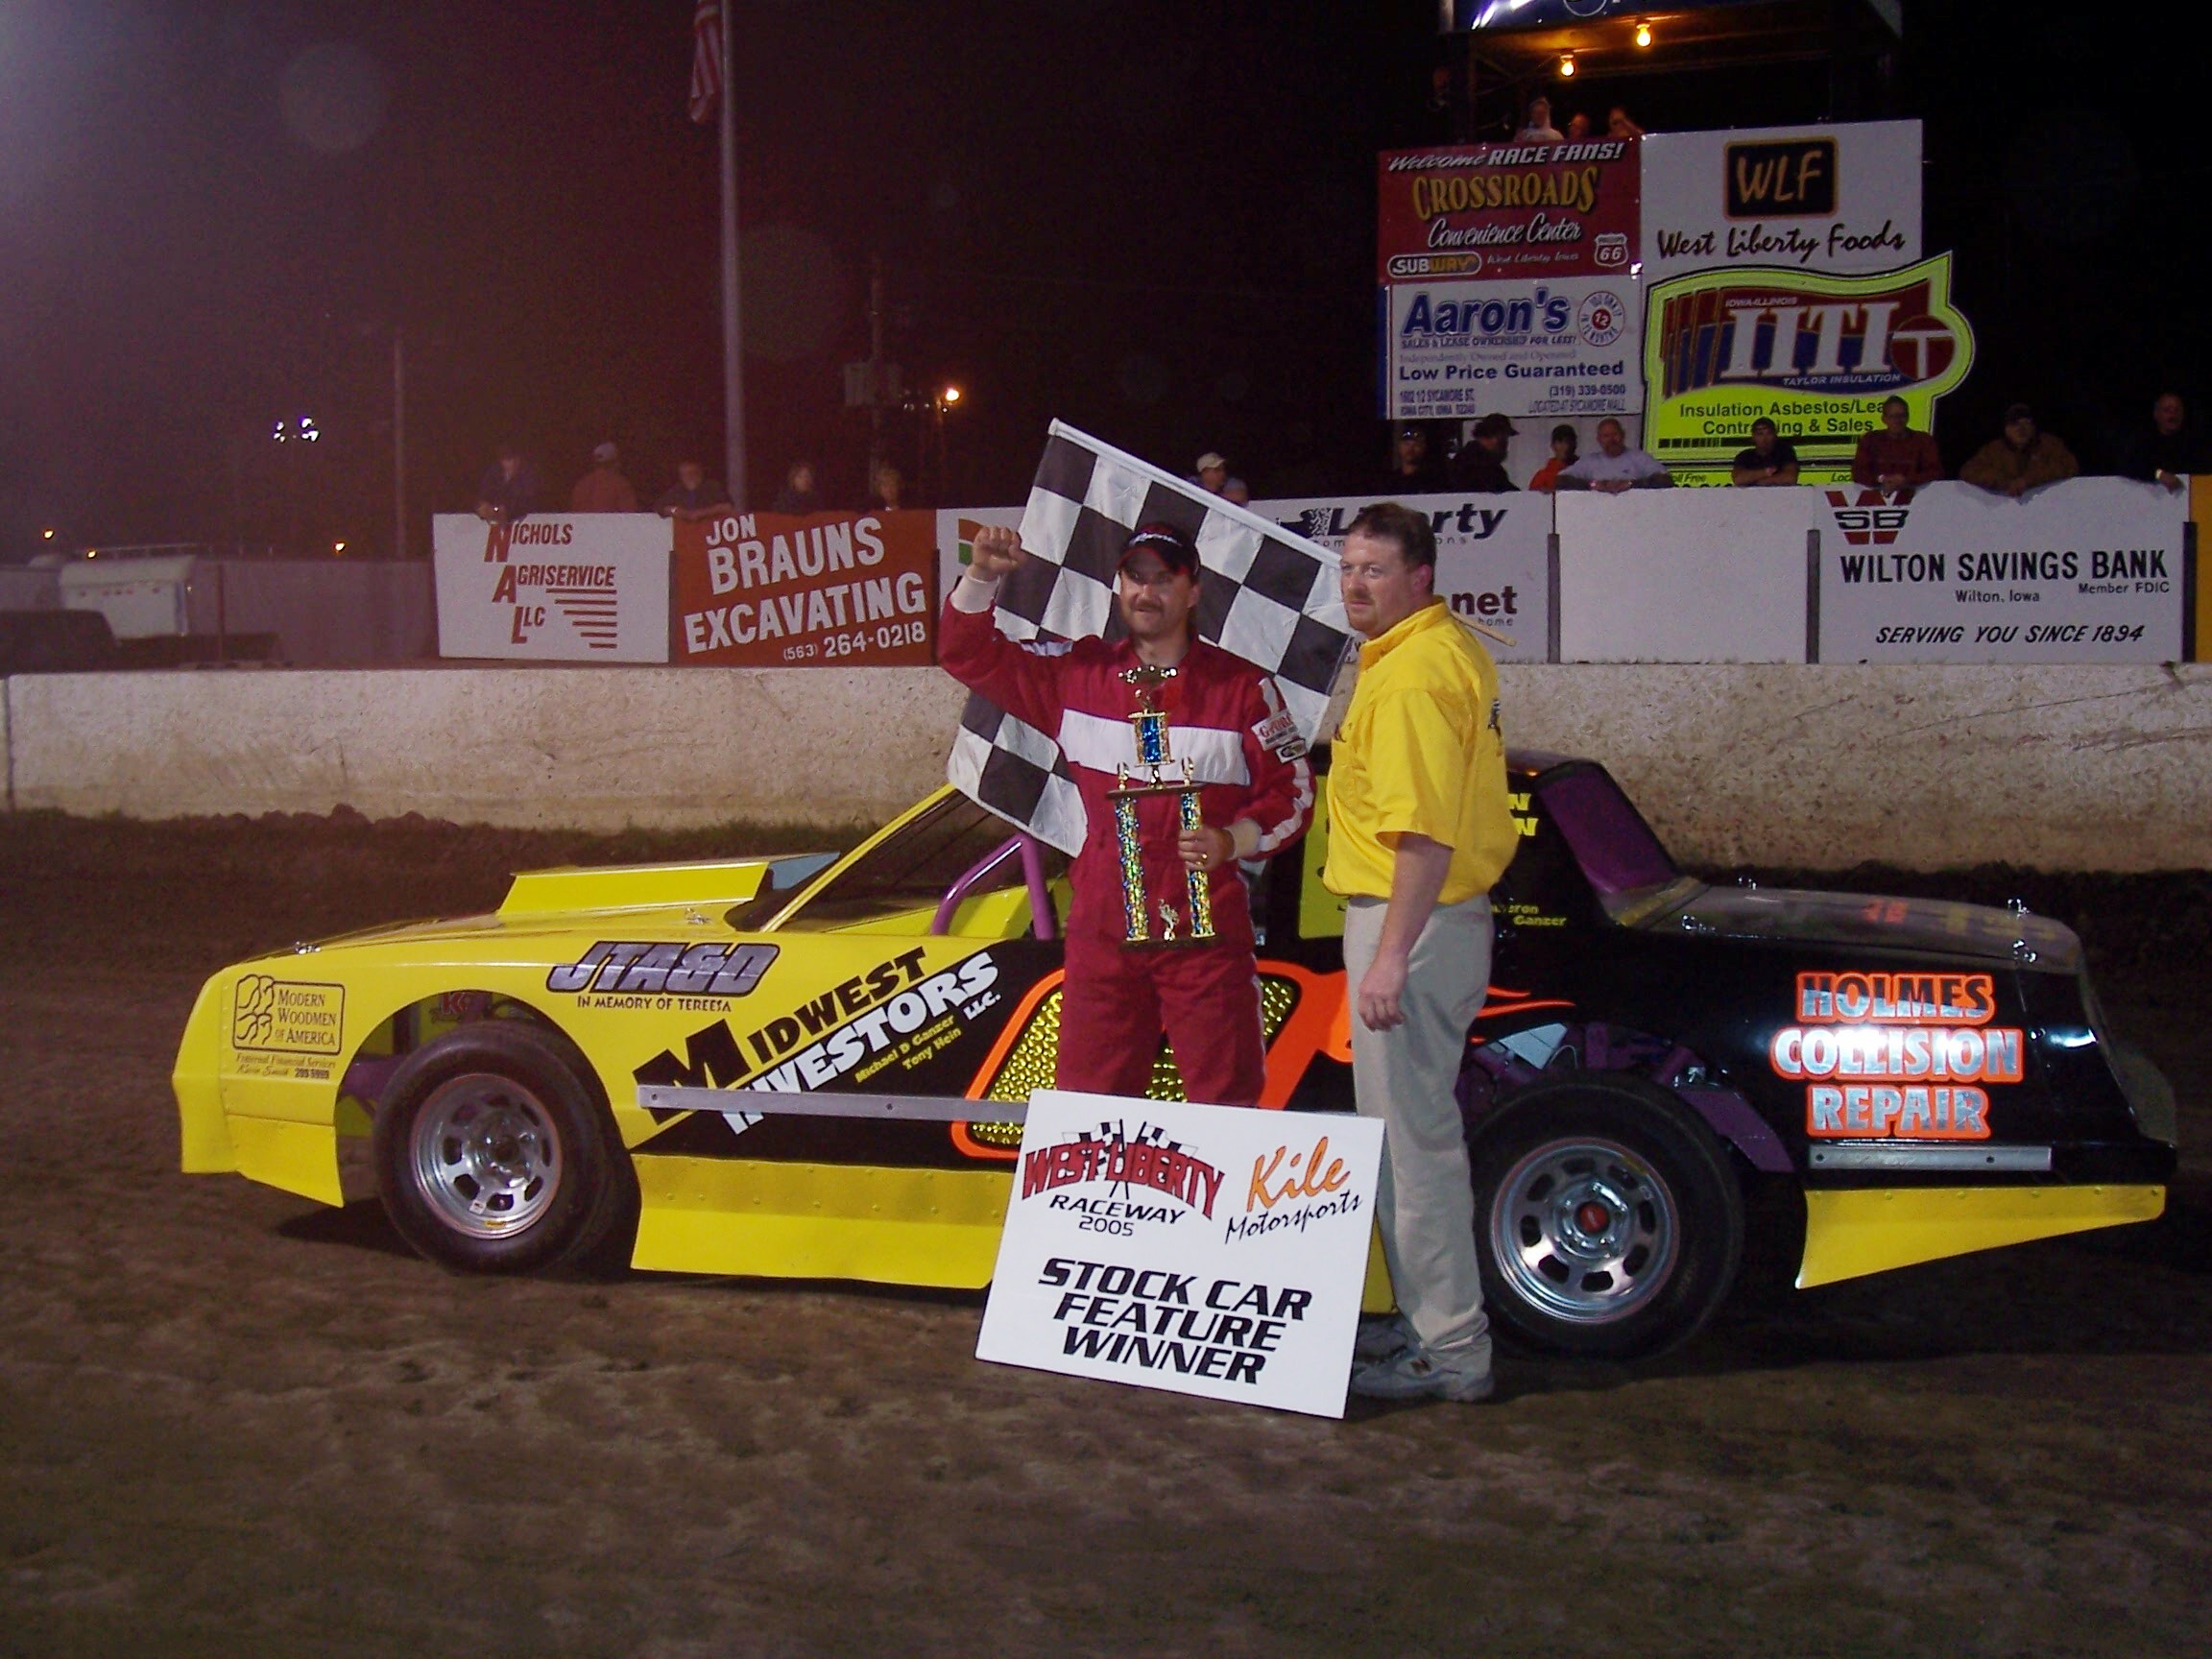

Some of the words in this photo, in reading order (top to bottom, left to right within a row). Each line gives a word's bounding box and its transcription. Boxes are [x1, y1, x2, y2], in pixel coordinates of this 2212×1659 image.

[1388, 155, 1487, 172] Welcome
[1488, 146, 1549, 166] RACE
[1551, 142, 1623, 162] FANS!
[1412, 166, 1599, 221] CROSSROADS
[1735, 149, 1823, 204] WLF
[1428, 217, 1525, 249] Convenience
[1527, 212, 1582, 244] Center
[1657, 228, 1716, 259] West
[1727, 224, 1820, 263] Liberty
[1827, 219, 1907, 258] Foods
[1392, 256, 1476, 274] SUBWAY
[1598, 247, 1623, 261] 66
[1401, 287, 1571, 336] Aaron's
[1595, 311, 1609, 326] 12
[1400, 366, 1439, 380] Low
[1446, 364, 1498, 379] Price
[1505, 360, 1623, 378] Guaranteed
[1782, 375, 1827, 386] TAYLOR
[1830, 373, 1901, 384] INSULATION
[1680, 401, 1764, 418] Insulation
[1769, 399, 1884, 417] Asbestos/Lea
[1703, 420, 1802, 437] Contring
[1809, 418, 1826, 432] &
[1827, 418, 1873, 433] Sales
[484, 522, 573, 563] NICHOLS
[706, 513, 757, 546] JON
[708, 517, 885, 596] BRAUNS
[1840, 553, 1945, 584] WILTON
[1958, 550, 2079, 582] SAVINGS
[2092, 549, 2168, 579] BANK
[492, 565, 616, 604] AGRISERVICE
[2009, 589, 2040, 603] Iowa
[2079, 582, 2129, 595] Member
[2135, 581, 2170, 593] FDIC
[684, 571, 926, 655] EXCAVATING
[782, 642, 819, 662] (563)
[824, 620, 927, 659] 264-0218
[1875, 625, 1964, 644] SERVING
[1975, 625, 2017, 643] YOU
[2025, 624, 2089, 643] SINCE
[2092, 624, 2146, 642] 1894
[277, 988, 325, 1007] MODERN
[577, 997, 591, 1008] IN
[594, 996, 654, 1010] MEMORY
[657, 998, 673, 1011] OF
[678, 998, 732, 1013] TEREESA
[1797, 971, 1995, 1023] HOLMES
[277, 1007, 337, 1028] WOODMEN
[285, 1028, 336, 1046] AMERICA
[632, 946, 927, 1125] MIDWEST
[854, 1048, 900, 1084] Michael
[902, 1046, 933, 1070] Tony
[1770, 1027, 2024, 1083] COLLISION
[1807, 1085, 1991, 1140] REPAIR
[1247, 1136, 1352, 1213] Kile
[1049, 1194, 1186, 1225] RACEWAY
[1078, 1216, 1135, 1237] 2005
[1225, 1189, 1364, 1244] Motorsports
[1038, 1258, 1198, 1305] STOCK
[1206, 1279, 1312, 1321] CAR
[1053, 1291, 1287, 1353] FEATURE
[1062, 1326, 1267, 1385] WINNER
